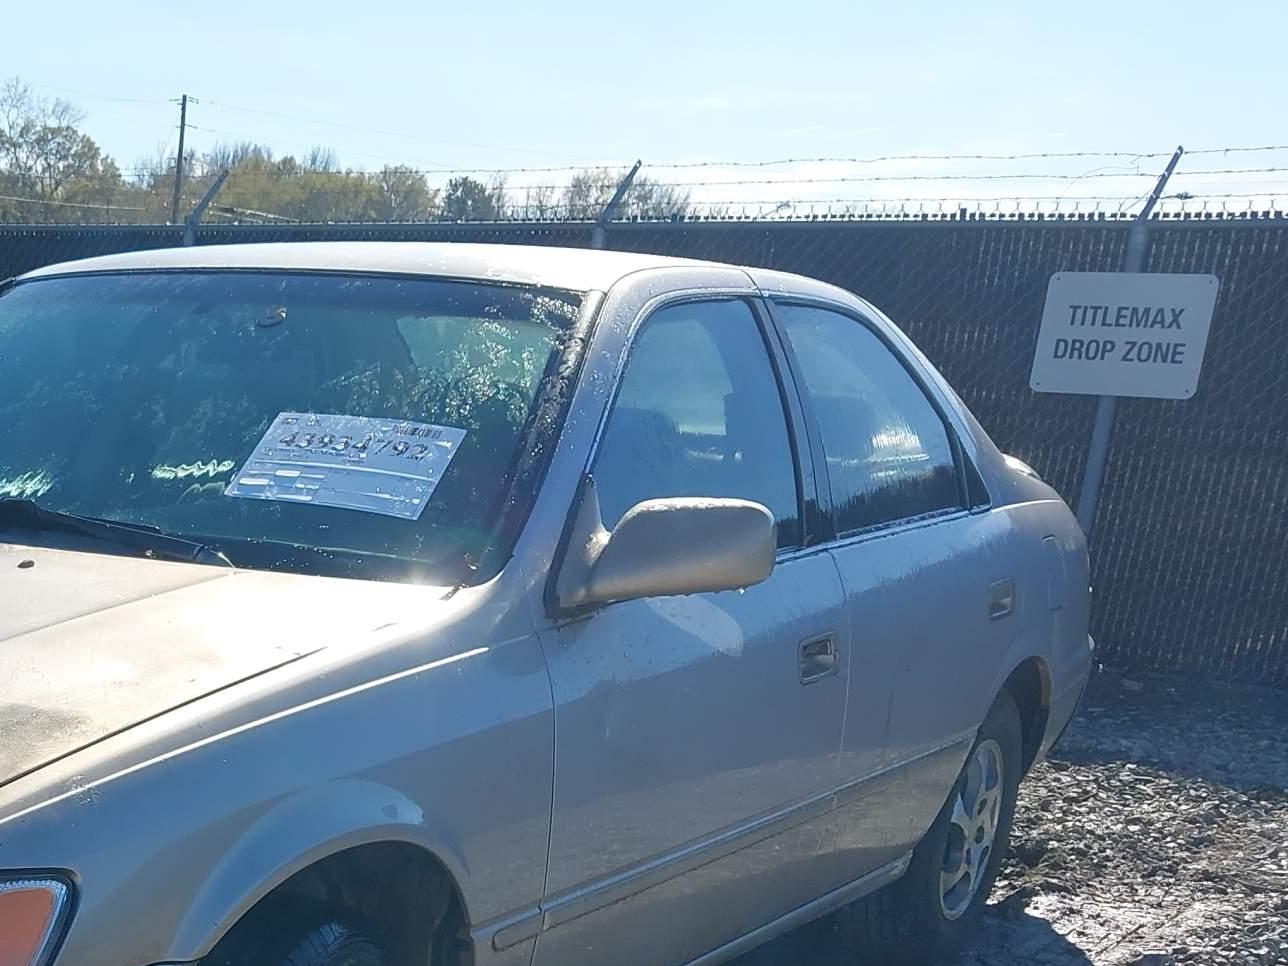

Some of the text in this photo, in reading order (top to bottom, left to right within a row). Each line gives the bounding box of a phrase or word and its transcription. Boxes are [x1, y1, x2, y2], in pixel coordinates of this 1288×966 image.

[1068, 304, 1185, 330] TITLEMAX
[1053, 338, 1187, 365] DROP ZONE
